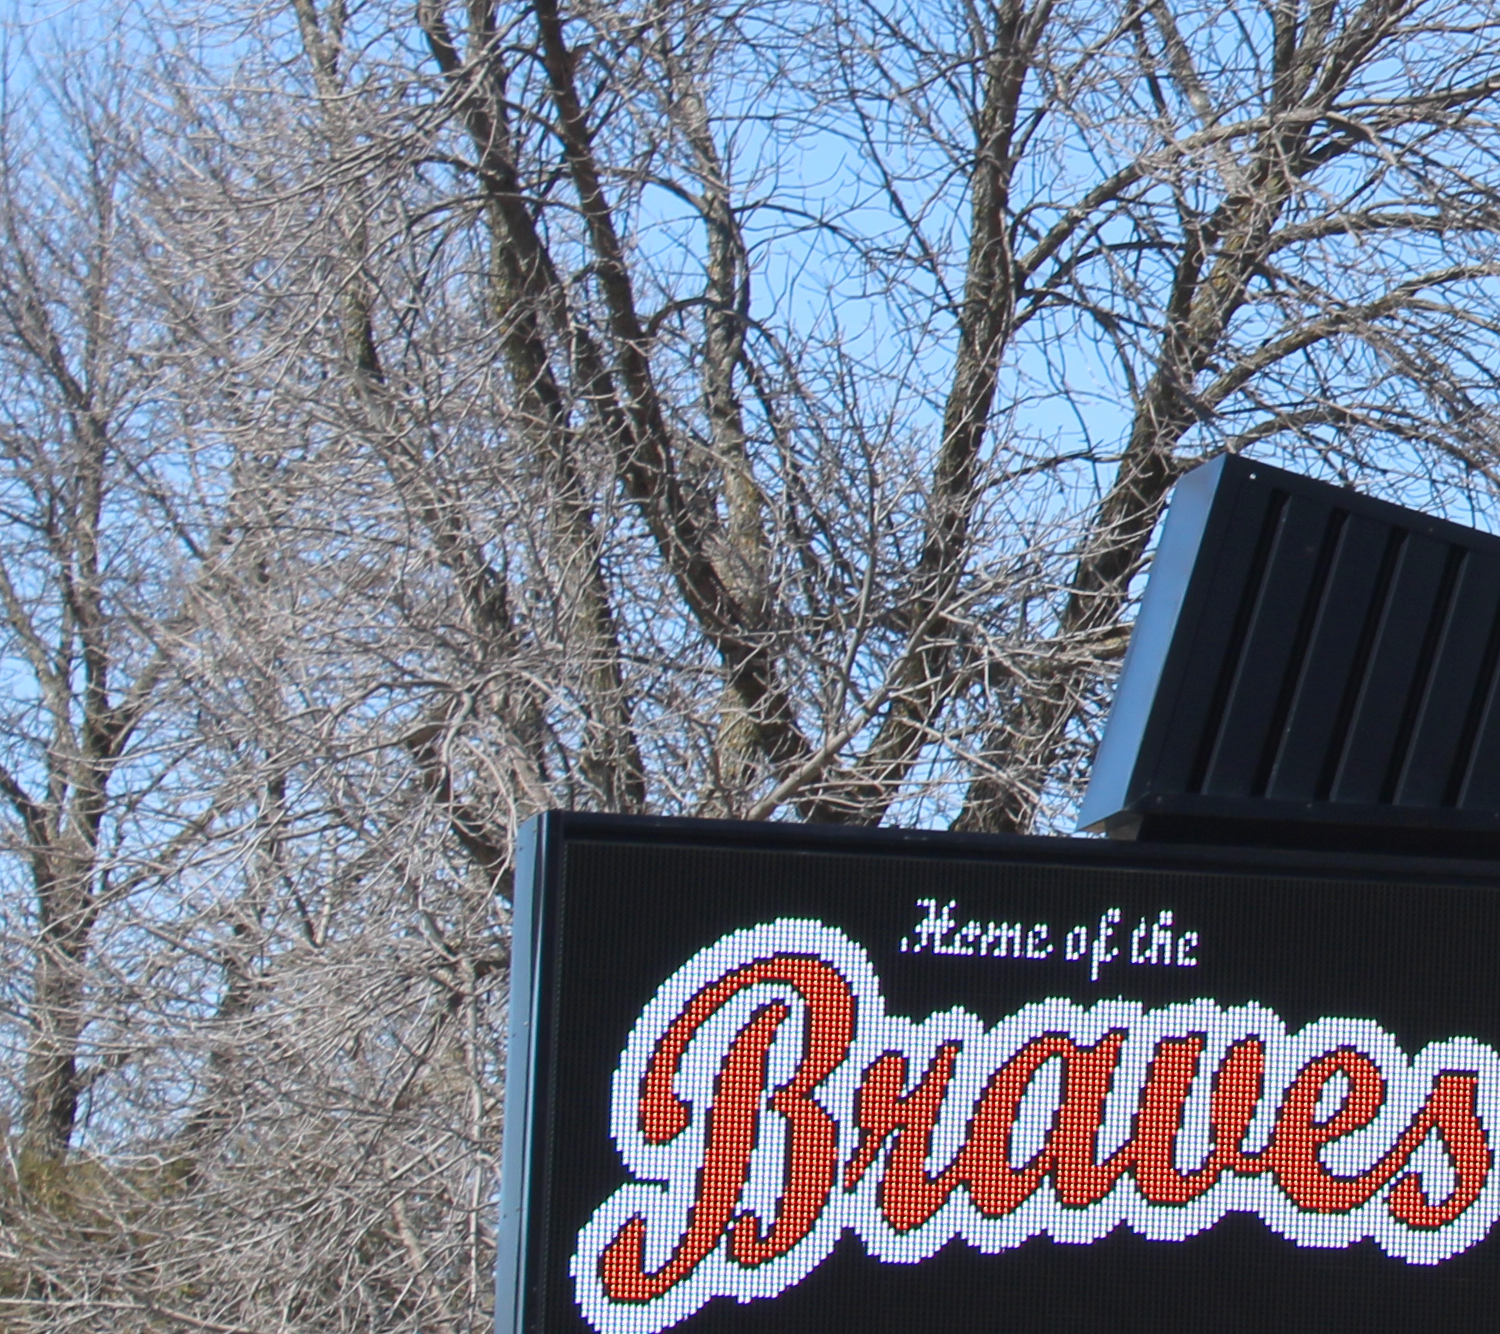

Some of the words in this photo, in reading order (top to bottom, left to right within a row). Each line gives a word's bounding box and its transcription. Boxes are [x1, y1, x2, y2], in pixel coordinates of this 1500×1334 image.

[900, 898, 1054, 959] Home
[1065, 908, 1121, 981] of
[1131, 910, 1198, 966] the
